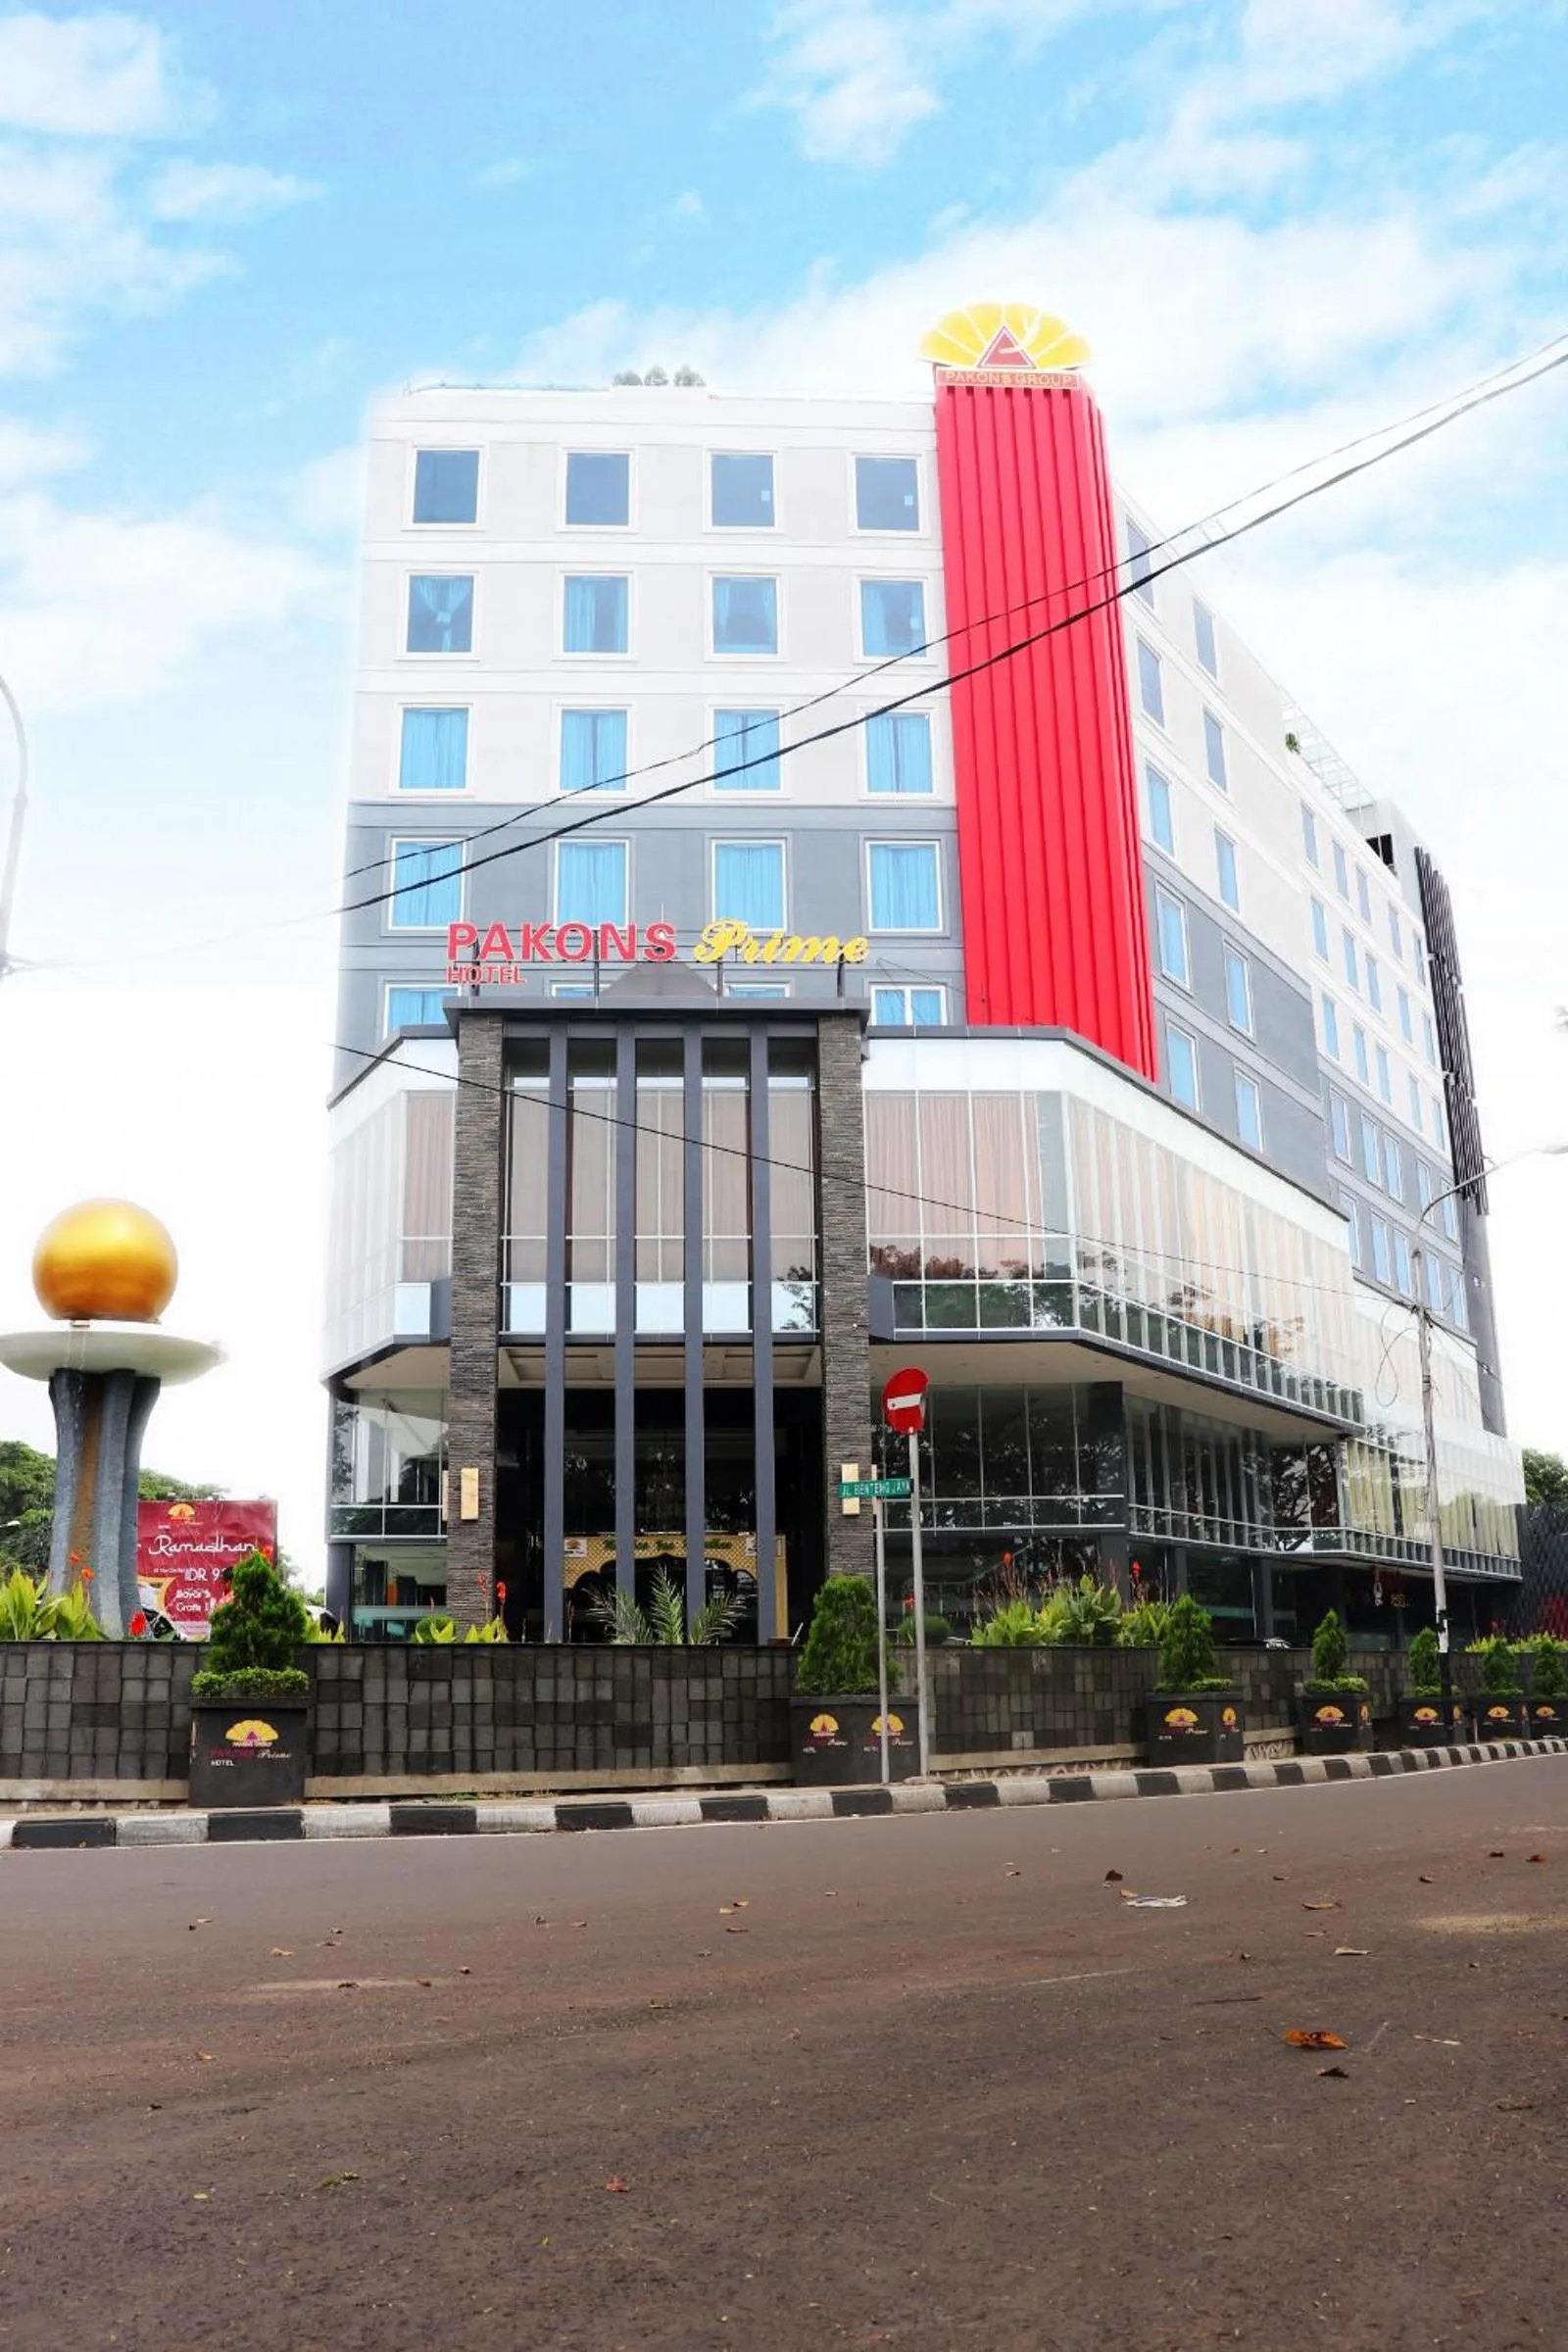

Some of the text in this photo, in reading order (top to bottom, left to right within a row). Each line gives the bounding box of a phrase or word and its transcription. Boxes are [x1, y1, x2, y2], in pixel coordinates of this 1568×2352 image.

[945, 371, 1072, 387] PAKONS GROUP
[447, 917, 870, 964] PAKONS Prime
[446, 965, 525, 985] HOTEL
[148, 1531, 258, 1556] Ramadhan
